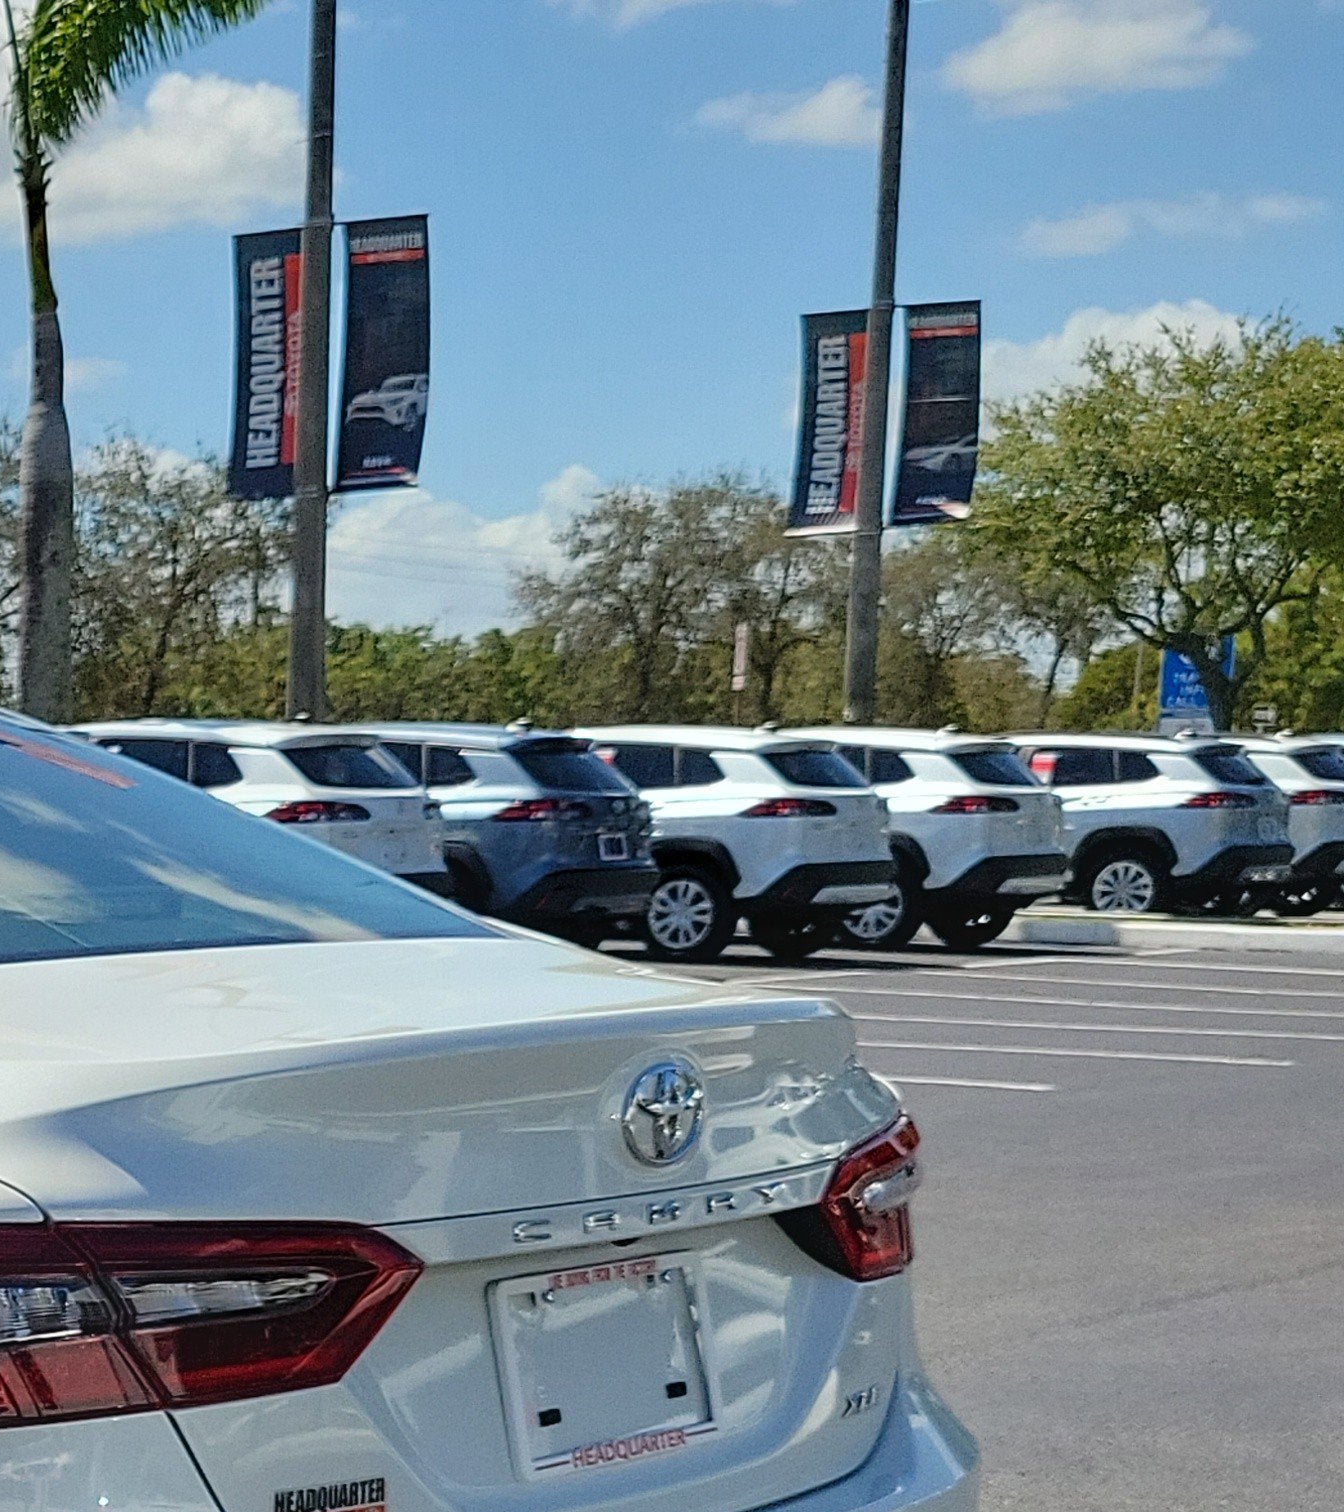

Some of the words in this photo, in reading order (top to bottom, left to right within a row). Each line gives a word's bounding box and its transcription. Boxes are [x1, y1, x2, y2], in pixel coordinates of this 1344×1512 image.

[246, 256, 286, 469] HEADQUARTER
[805, 334, 848, 515] HEADQUARTER
[512, 1181, 787, 1244] CAMRY
[572, 1428, 686, 1469] HEADQUARTER
